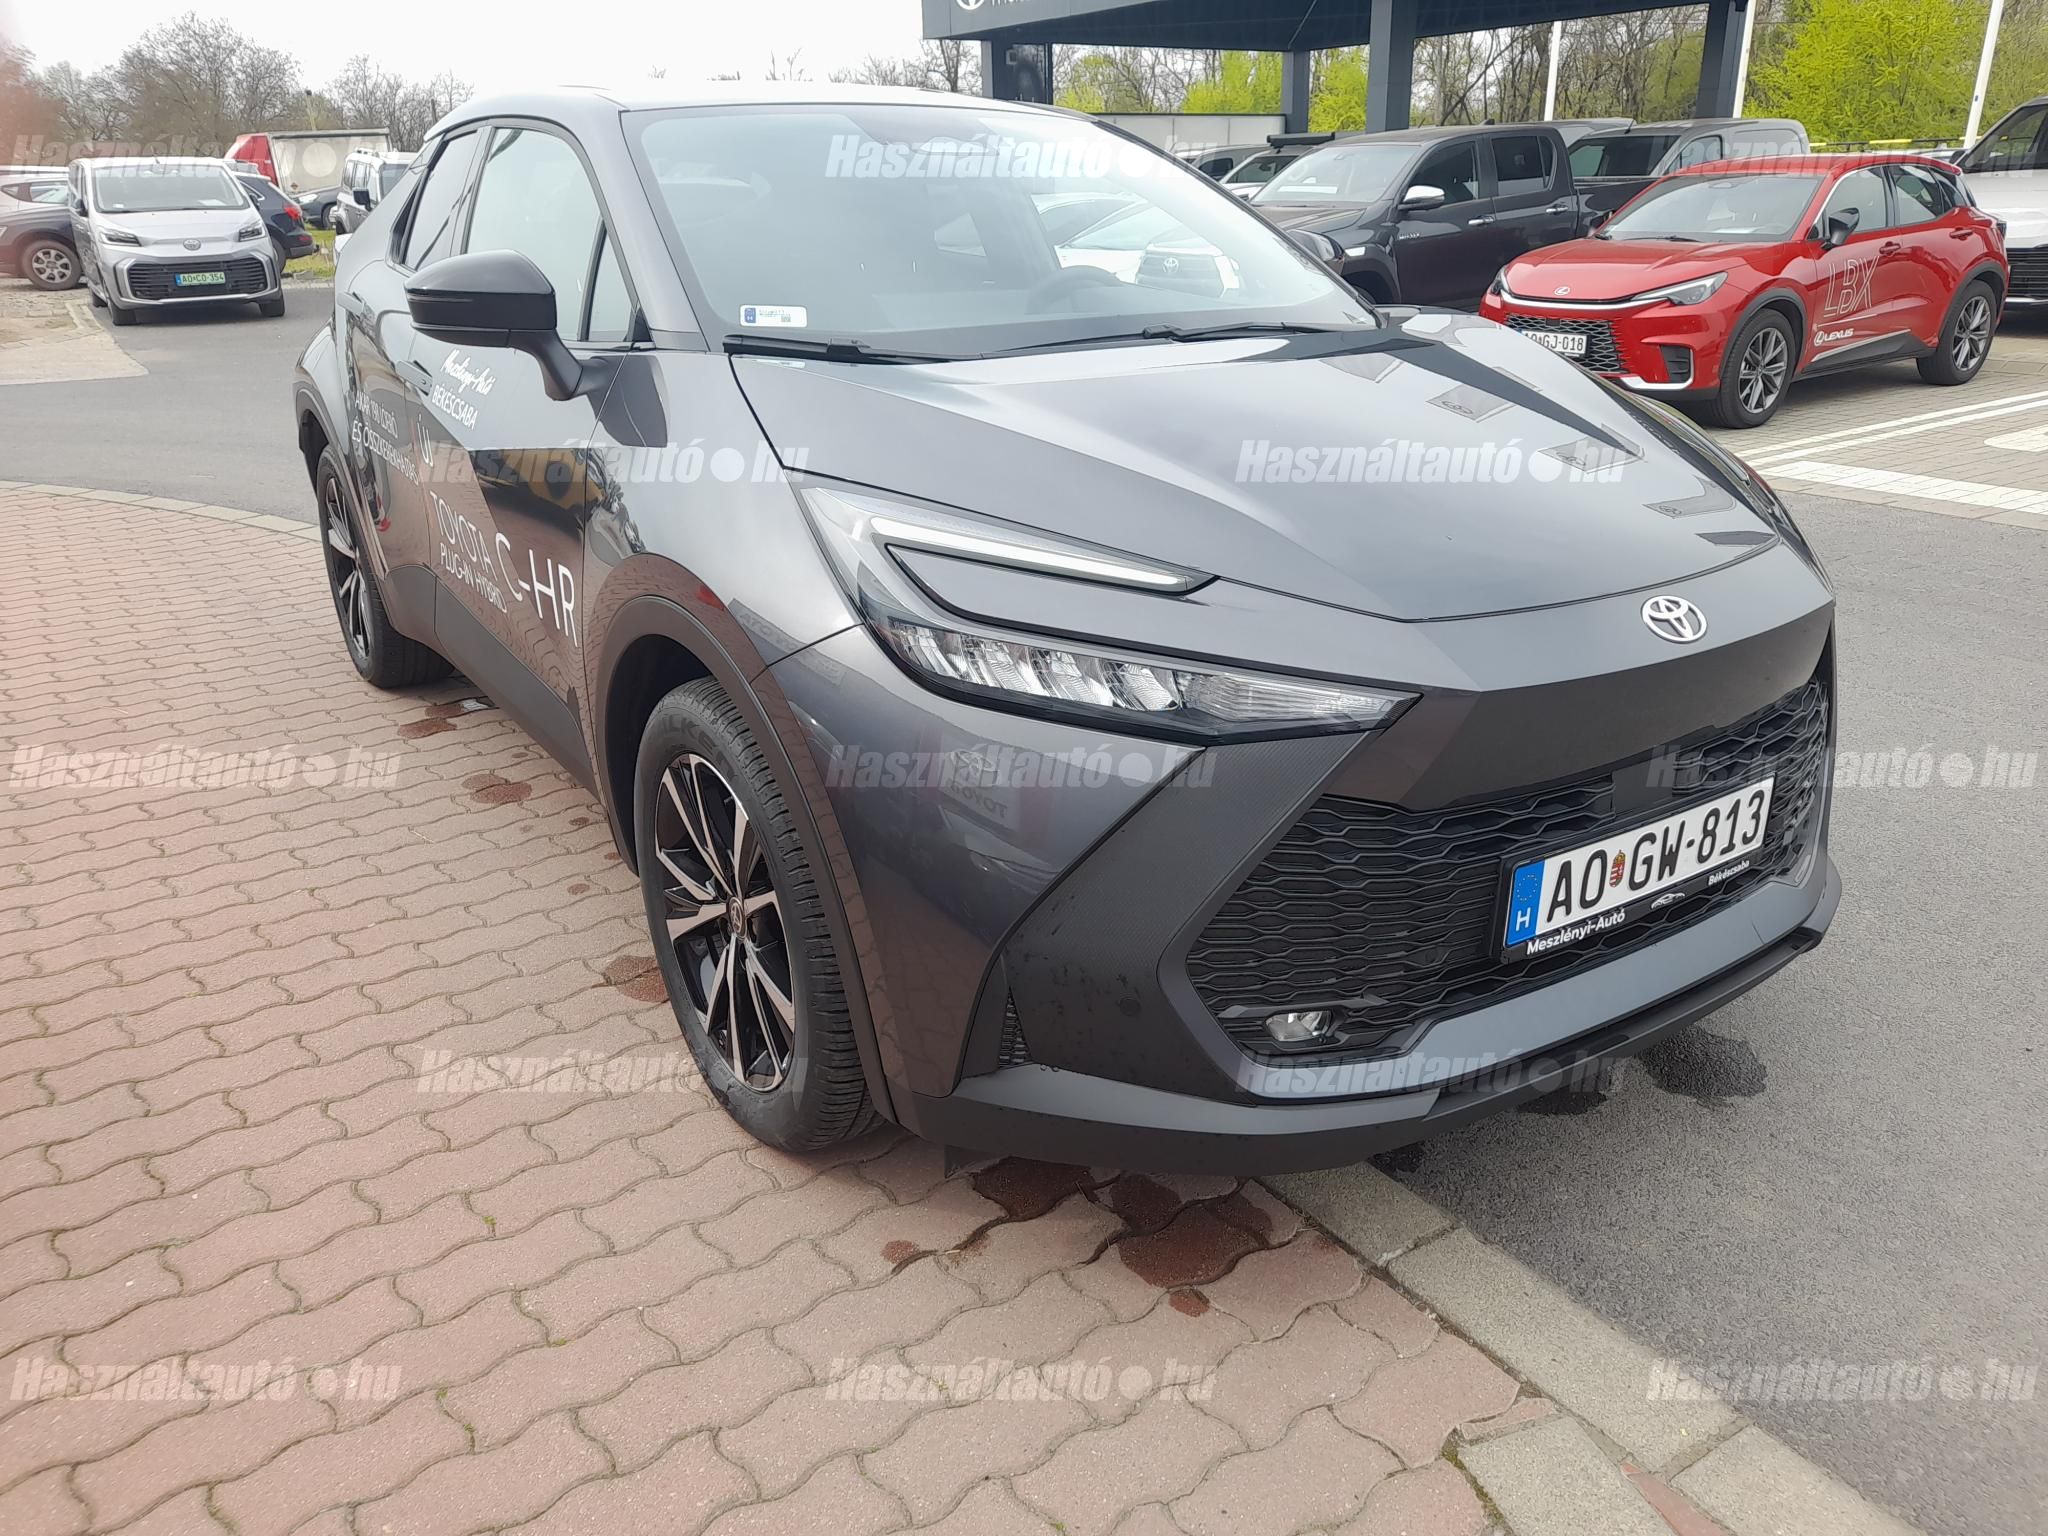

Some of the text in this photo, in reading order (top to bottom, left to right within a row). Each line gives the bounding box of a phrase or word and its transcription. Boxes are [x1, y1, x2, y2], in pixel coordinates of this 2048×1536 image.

[1824, 256, 1879, 317] LBX
[1824, 328, 1854, 341] LEXUS
[352, 415, 362, 443] ÉS
[432, 384, 479, 430] BÉKÉSCSABA
[417, 413, 434, 467] ÚJ
[430, 490, 578, 648] TOYOTA C-HR
[440, 542, 475, 588] PLUG-IN
[1515, 907, 1532, 932] H
[1526, 859, 1750, 955] Meszlényi-Autó Békéscsaba
